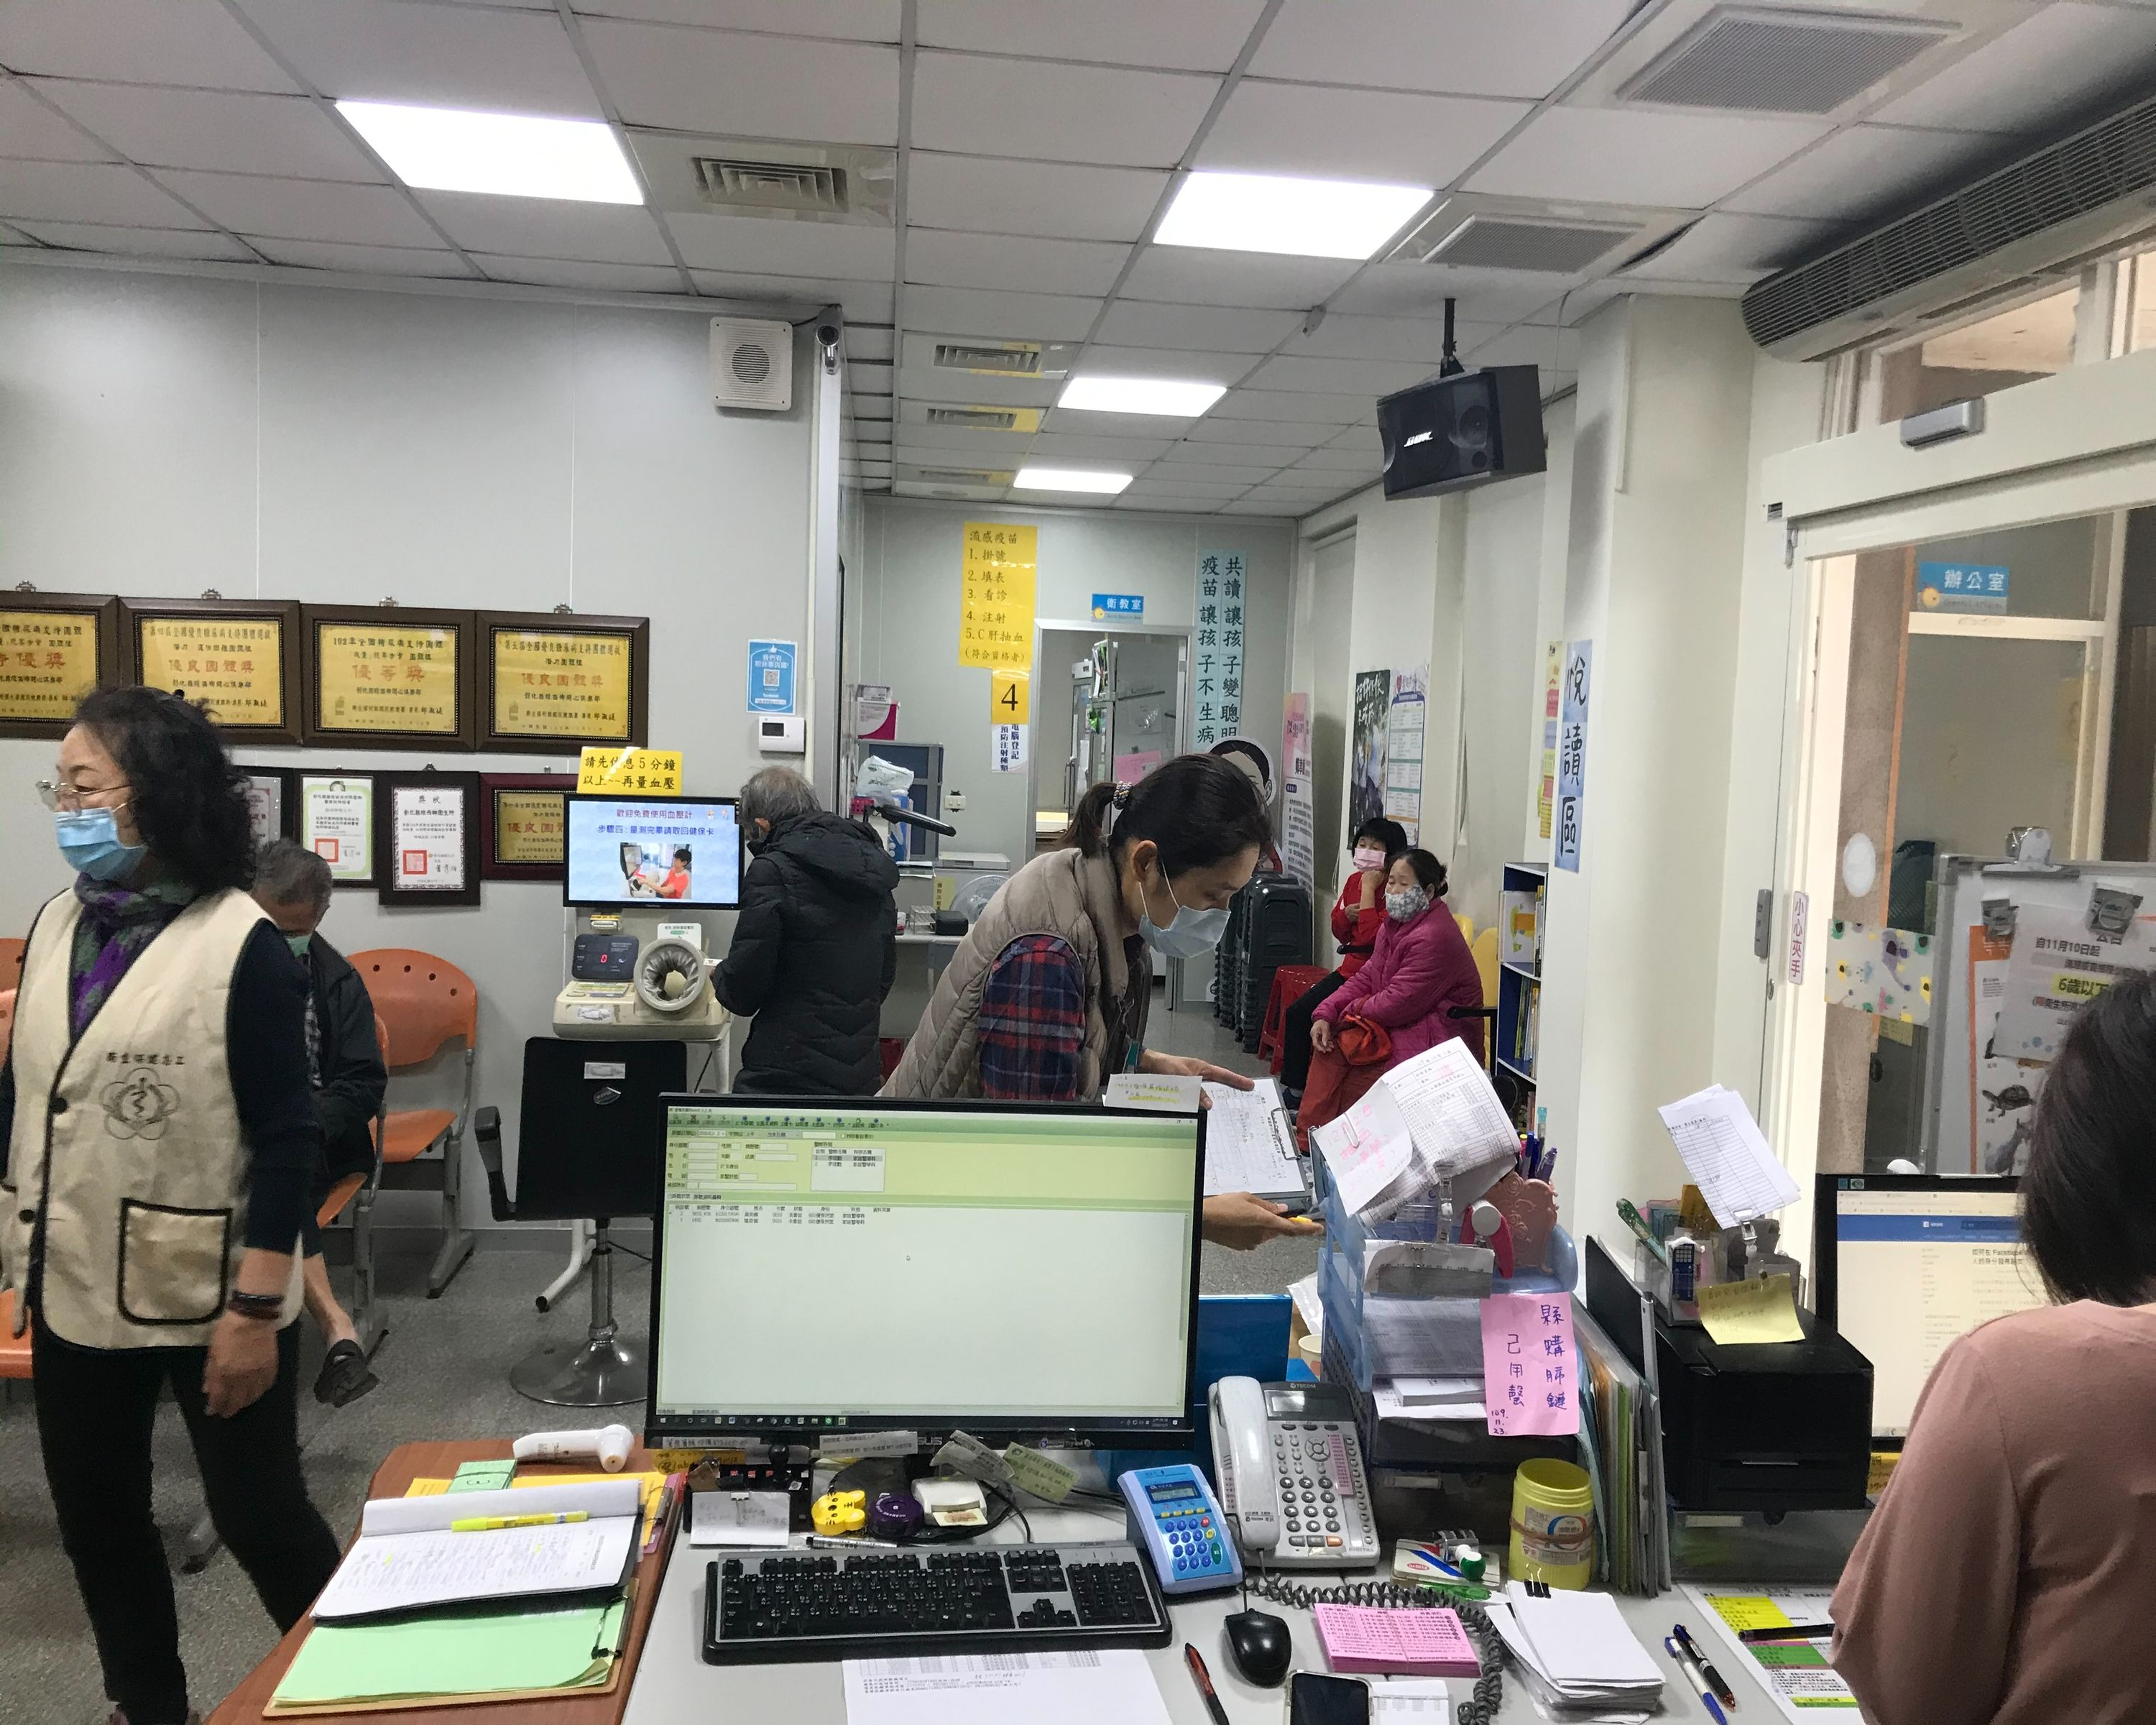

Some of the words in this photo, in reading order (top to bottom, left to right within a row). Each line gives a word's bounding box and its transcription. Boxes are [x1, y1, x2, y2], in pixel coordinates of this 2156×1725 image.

[970, 530, 1017, 544] 流感疫苗
[1945, 569, 2004, 592] 辦公室
[1107, 598, 1141, 610] 衛教室
[1197, 555, 1220, 745] 疫苗讓孩子不生病
[1220, 556, 1243, 738] 共讀讓孩子變聰明
[169, 659, 254, 673] 優良團體獎
[352, 665, 425, 682] 優等獎
[521, 673, 604, 688] 優良團體獎
[1001, 684, 1018, 711] 4
[1560, 655, 1585, 857] 悅讀區
[617, 809, 692, 819] 歡迎免費使用血壓計
[1791, 898, 1805, 978] 小心夾手
[2035, 937, 2101, 957] 自11月10日起
